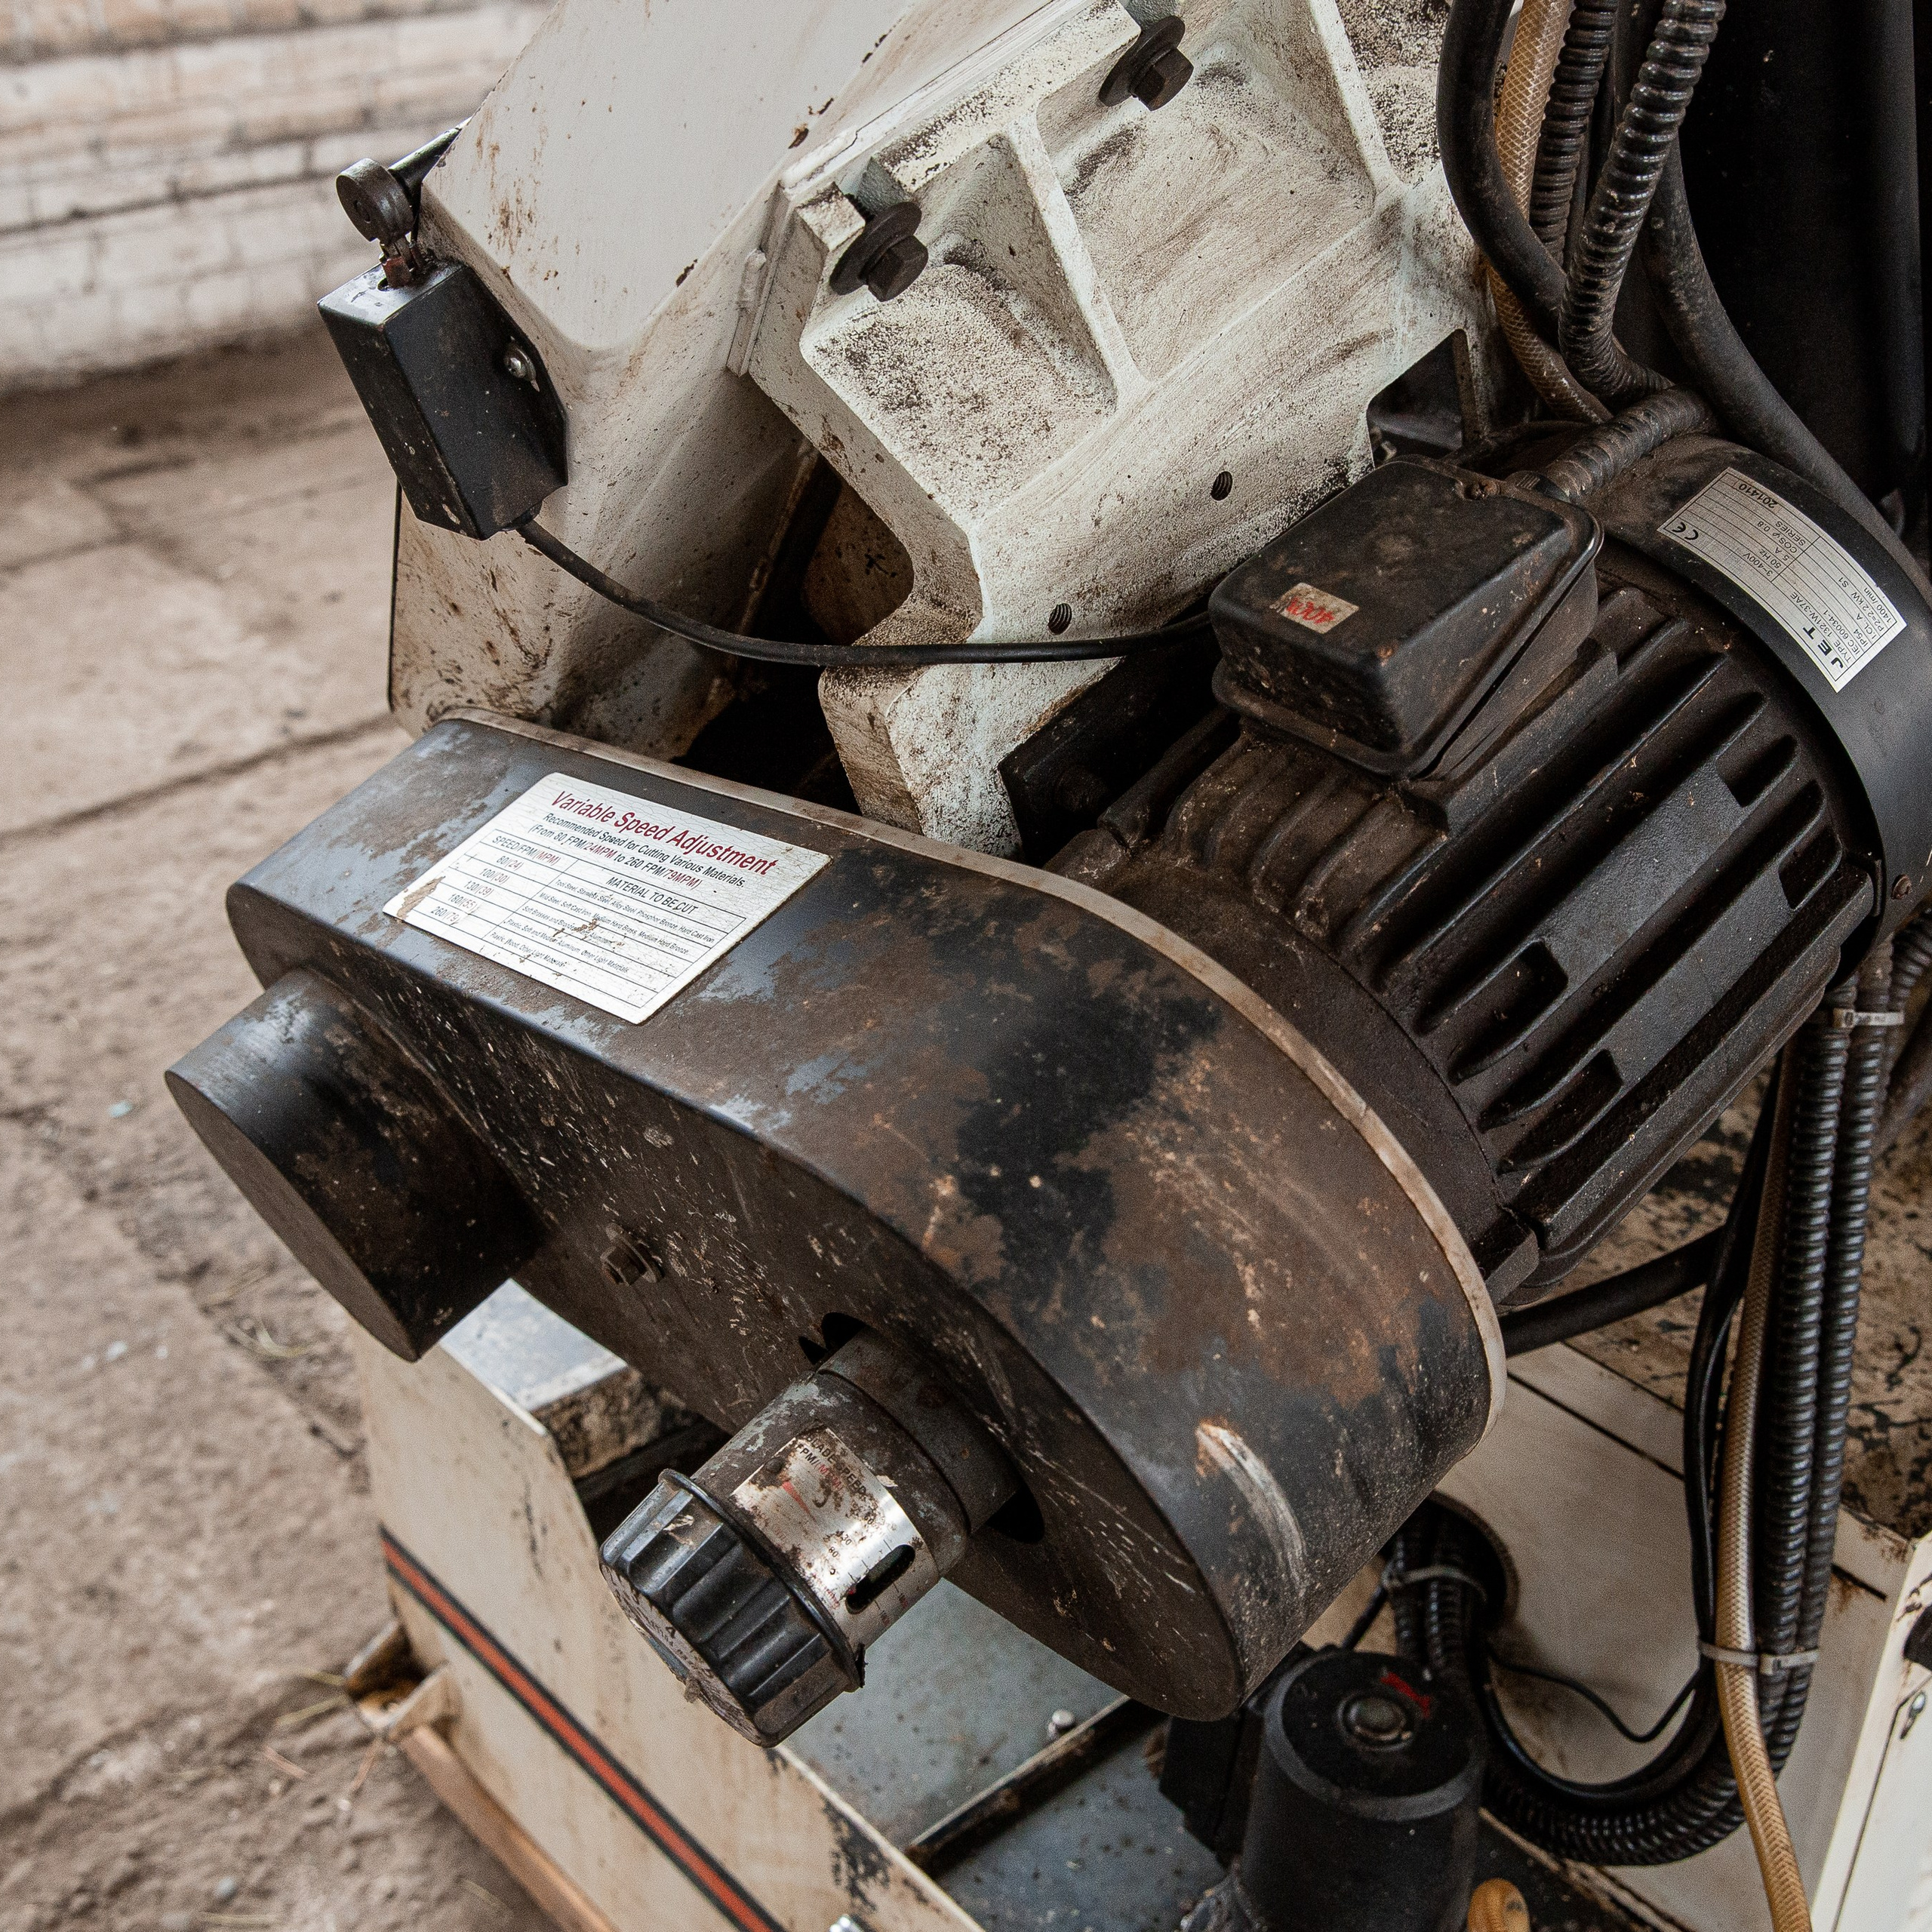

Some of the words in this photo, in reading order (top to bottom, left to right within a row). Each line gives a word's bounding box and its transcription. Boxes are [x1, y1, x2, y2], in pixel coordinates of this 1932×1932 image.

[1737, 482, 1777, 508] 201410
[1756, 519, 1770, 533] 0.8
[1774, 519, 1806, 546] SERIES
[1758, 548, 1770, 560] Hz
[1773, 546, 1782, 555] A
[1782, 553, 1789, 561] 5
[1770, 558, 1782, 569] 50
[1837, 576, 1849, 588] S1
[1850, 590, 1864, 605] kW
[1862, 586, 1878, 605] /min
[1789, 591, 1833, 638] 1321W-37AE
[1822, 609, 1849, 639] 60034-1
[1854, 612, 1863, 621] A
[1862, 603, 1884, 632] P2=2.2
[1875, 603, 1892, 623] 1400
[1801, 622, 1844, 671] JET
[1846, 638, 1860, 654] IEC
[1852, 628, 1868, 647] IP54
[1832, 638, 1852, 662] TYPE
[552, 791, 616, 823] Variable
[614, 812, 675, 841] Speed
[666, 829, 779, 875] Adjustment
[528, 824, 555, 838] (From
[553, 832, 568, 841] 80
[565, 835, 618, 859] FPM/24MPM
[614, 854, 626, 863] to
[624, 857, 645, 868] 260
[641, 862, 703, 890] FPM/79MPM)
[543, 813, 602, 838] Recommended
[598, 832, 629, 846] Speed
[623, 840, 640, 851] for
[638, 844, 670, 863] Cutting
[669, 854, 704, 872] Various
[702, 866, 746, 888] Materials.
[606, 876, 650, 898] MATERIAL
[649, 891, 665, 903] TO
[661, 897, 678, 907] BE
[674, 902, 698, 915] CUT
[592, 913, 611, 924] Medium
[610, 920, 623, 928] Hard
[638, 931, 658, 942] Medium
[657, 939, 672, 947] Hard
[610, 900, 623, 909] Alloy
[636, 909, 661, 922] Phosphor
[678, 926, 694, 934] Hard
[691, 931, 705, 939] Cast
[580, 949, 595, 958] Other
[593, 955, 608, 964] Light
